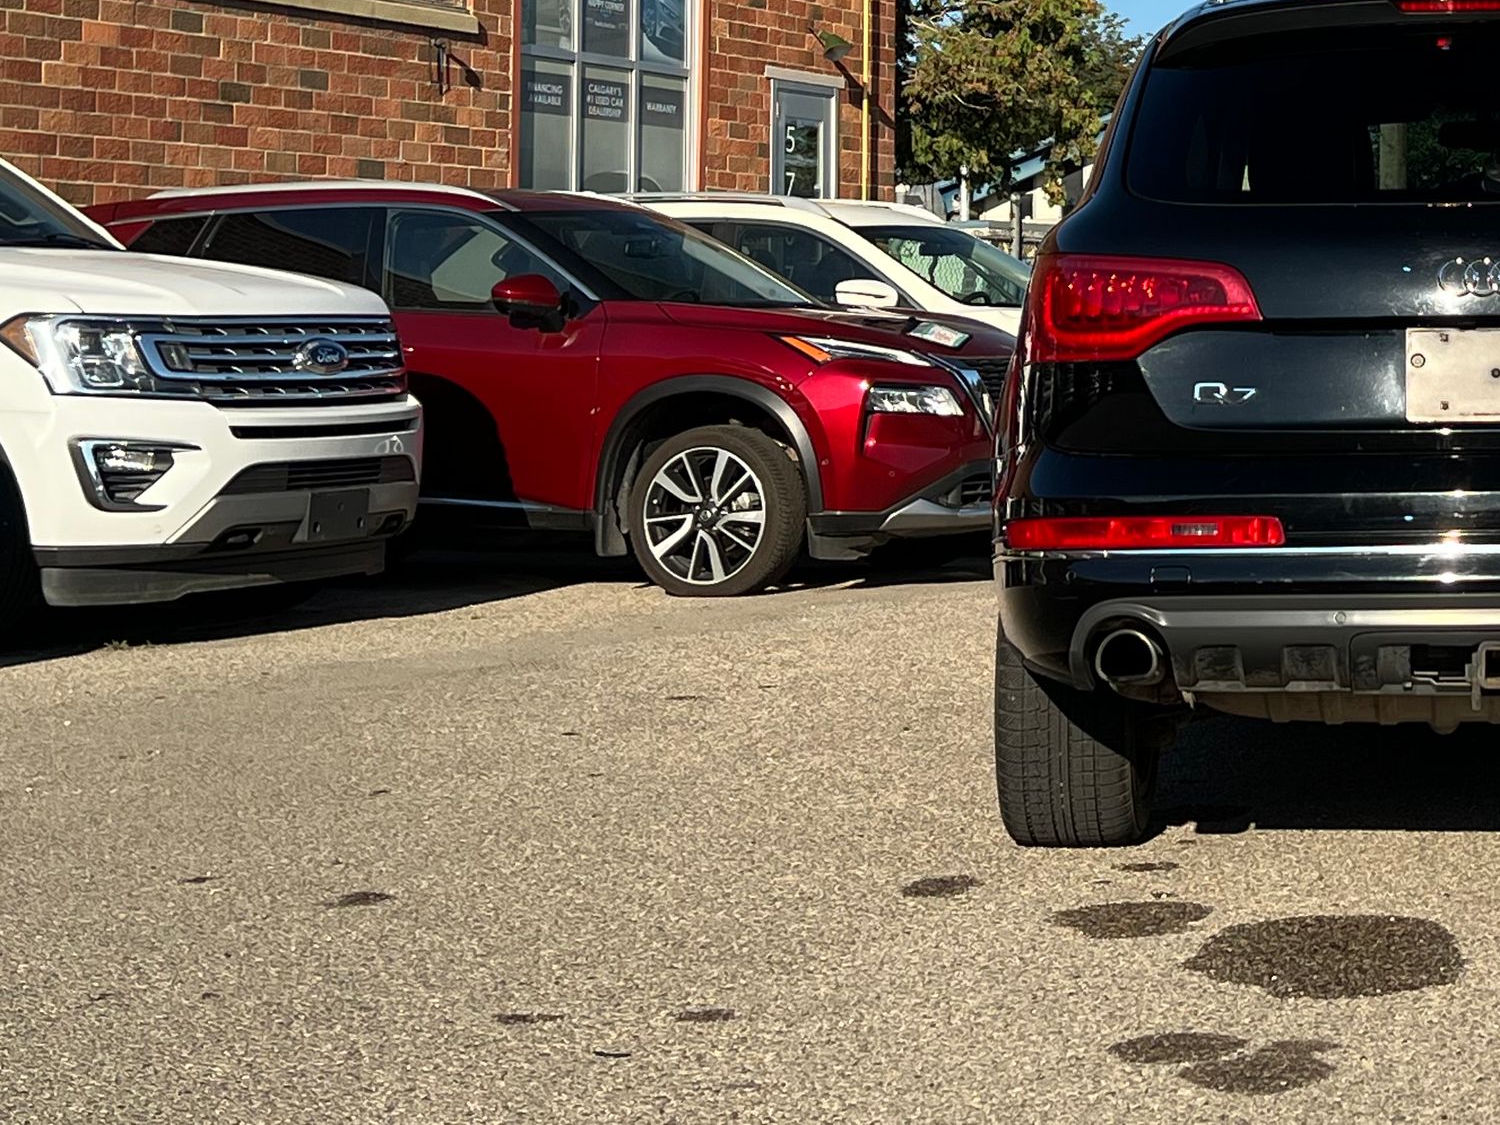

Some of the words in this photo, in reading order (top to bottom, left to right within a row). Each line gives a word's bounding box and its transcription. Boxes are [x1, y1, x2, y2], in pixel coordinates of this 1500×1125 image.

[610, 97, 624, 108] CAR
[785, 125, 796, 153] 5
[785, 172, 796, 197] 7
[316, 347, 340, 364] Ford
[1194, 382, 1256, 405] Q7
